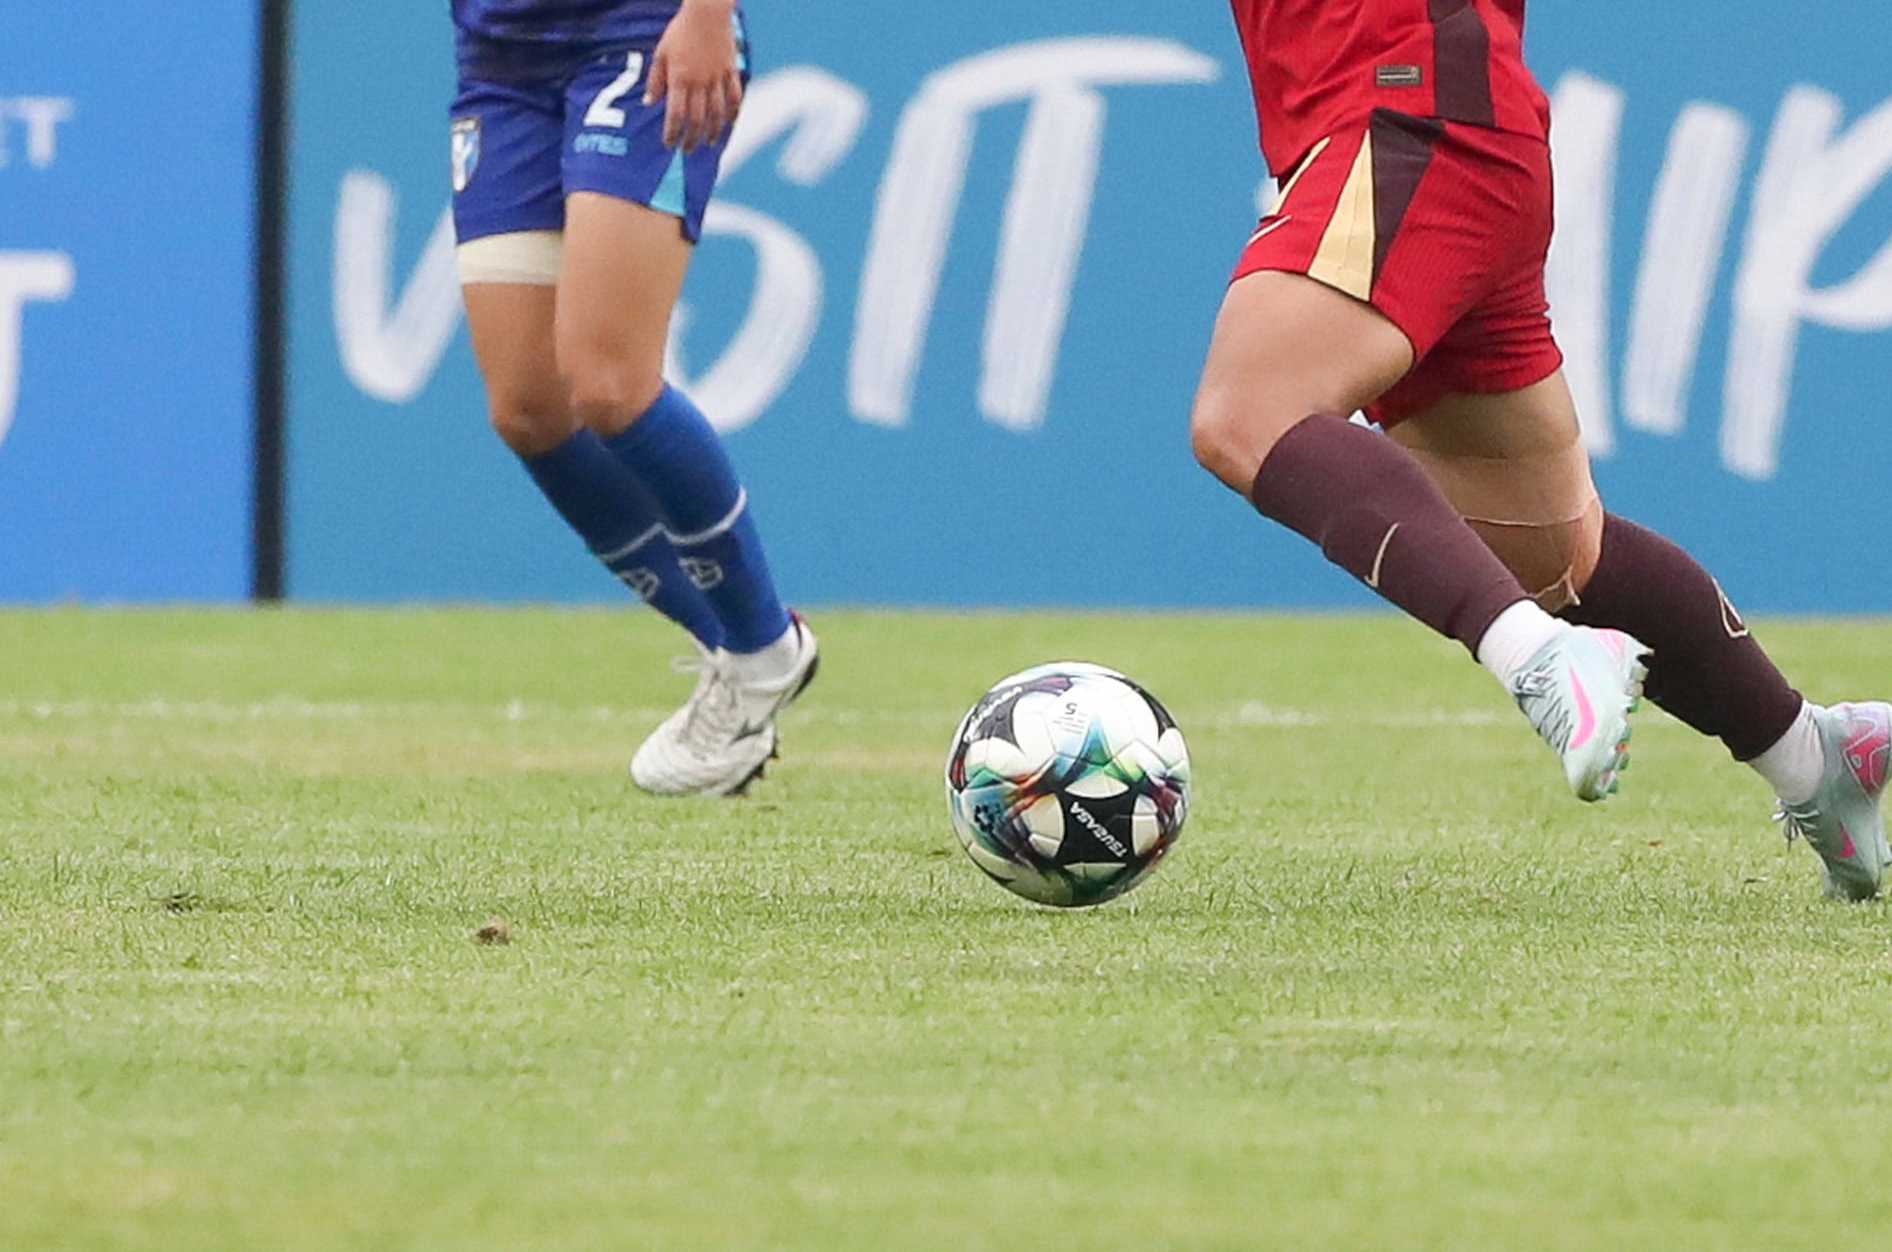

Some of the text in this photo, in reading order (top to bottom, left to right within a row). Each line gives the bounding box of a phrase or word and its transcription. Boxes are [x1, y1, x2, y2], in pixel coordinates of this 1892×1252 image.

[582, 51, 644, 128] 2
[331, 33, 1224, 436] VSIT
[1069, 801, 1127, 858] TSUBASA
